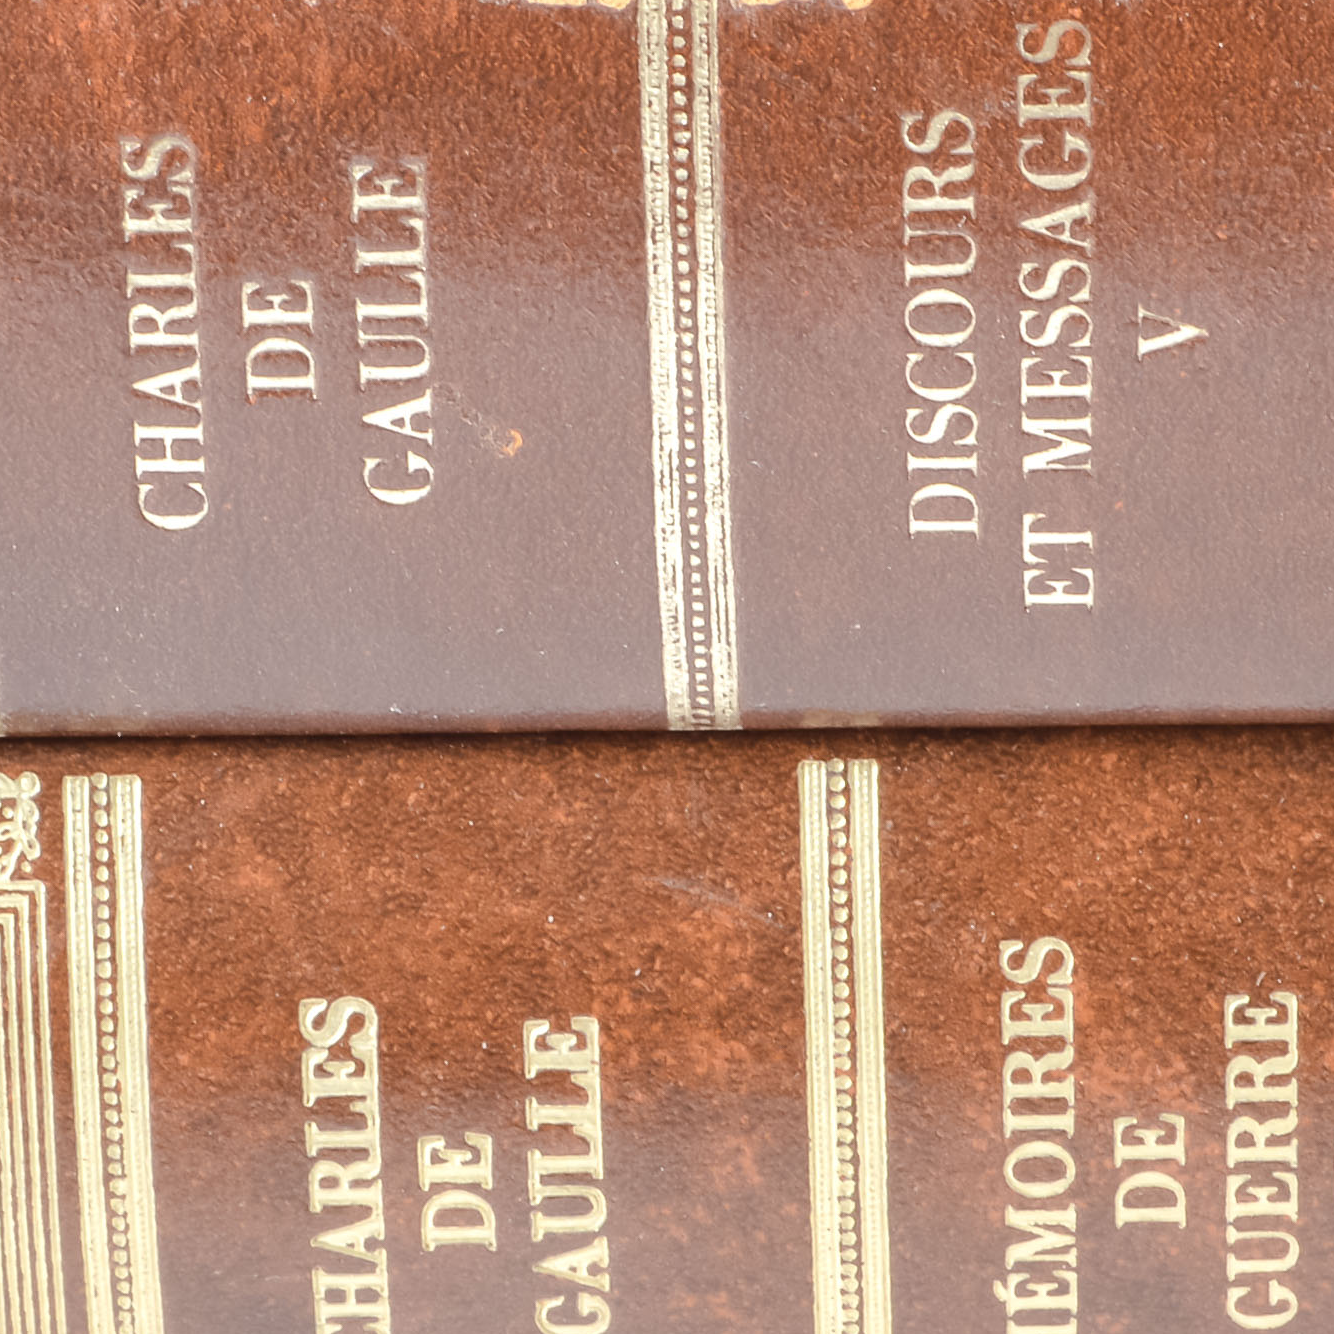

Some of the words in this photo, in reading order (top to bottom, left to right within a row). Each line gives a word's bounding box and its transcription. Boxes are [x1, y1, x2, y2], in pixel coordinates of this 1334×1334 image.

[120, 135, 208, 530] CHARLES
[241, 279, 317, 405] DE
[352, 155, 434, 503] GAULLE
[900, 109, 979, 538] DISCOURS
[1016, 18, 1094, 478] MESSAGES
[1137, 306, 1208, 358] V
[1022, 512, 1094, 611] ET
[418, 1132, 496, 1251] DE
[1114, 1113, 1186, 1229] DE
[1224, 991, 1300, 1330] GUERRE
